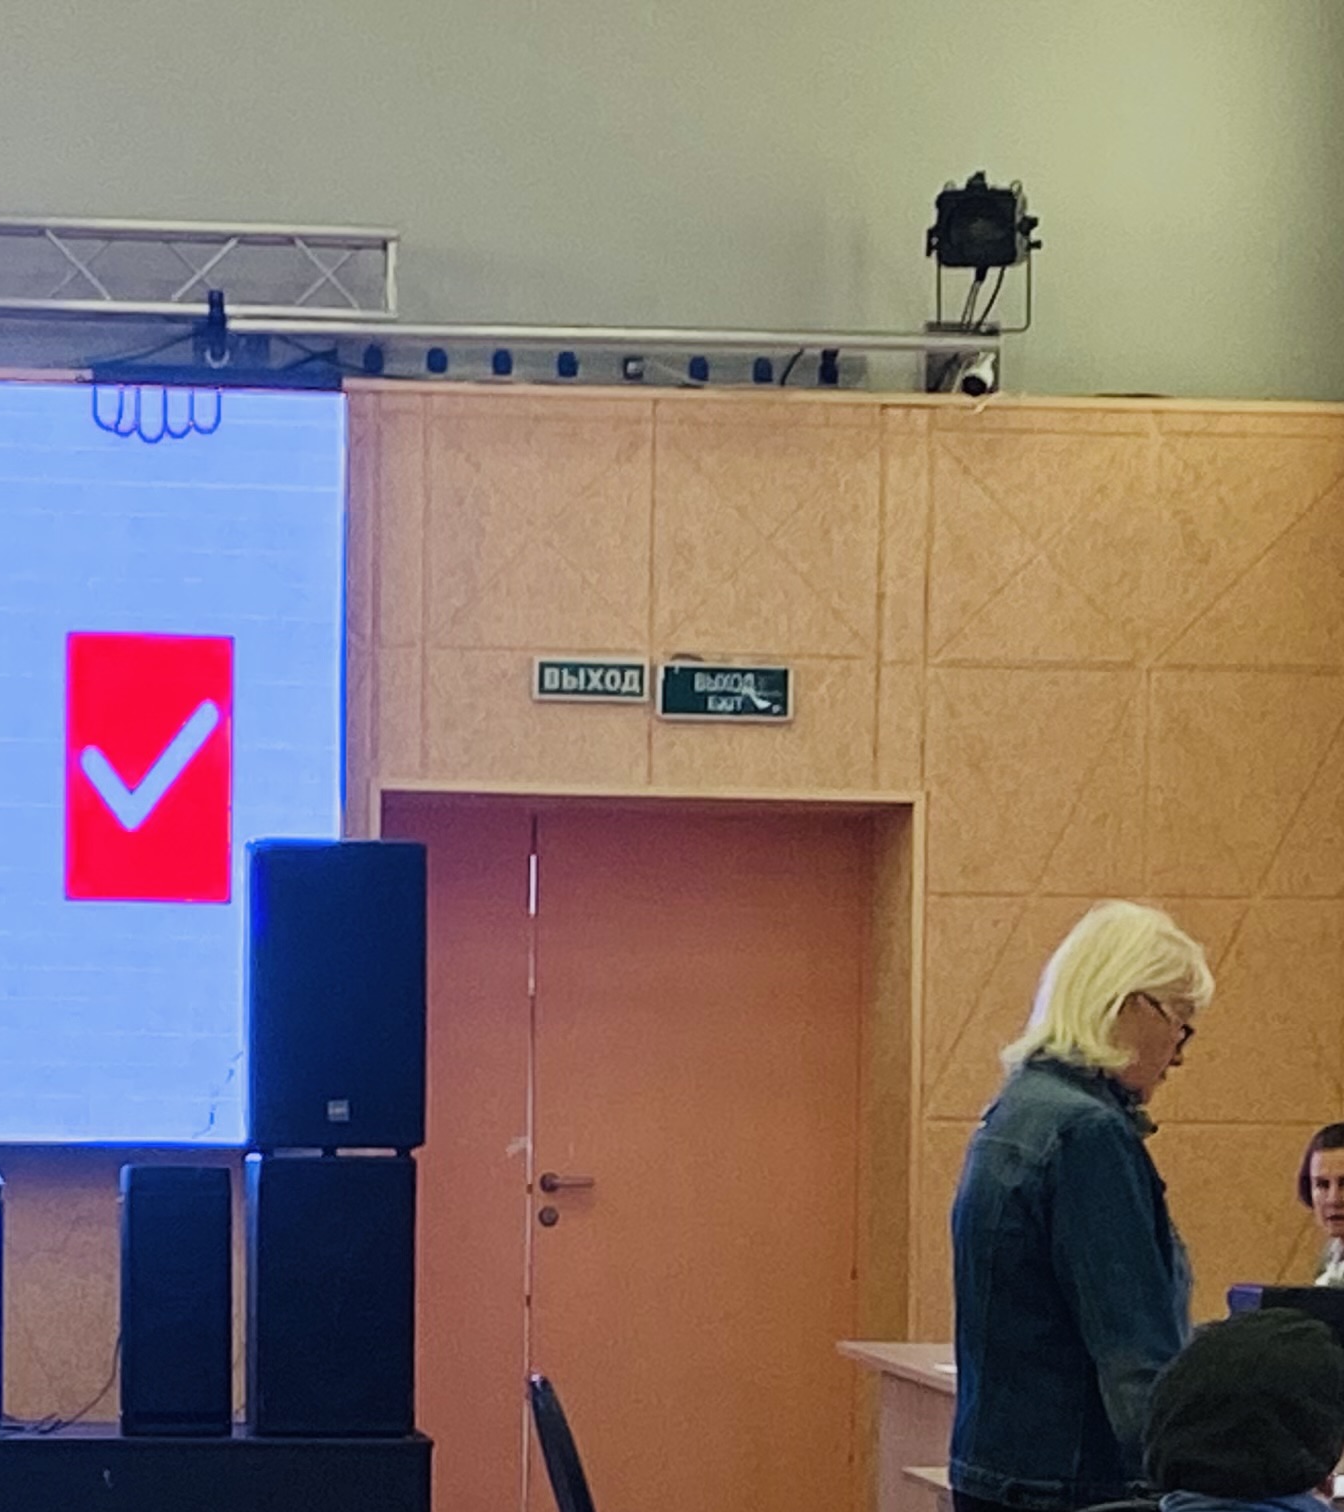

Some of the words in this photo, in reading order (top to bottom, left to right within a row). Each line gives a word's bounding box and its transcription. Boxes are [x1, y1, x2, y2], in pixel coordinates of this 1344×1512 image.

[543, 667, 641, 693] ВЫХОД
[694, 671, 755, 693] ВЫХОД
[707, 696, 743, 712] EXIT
